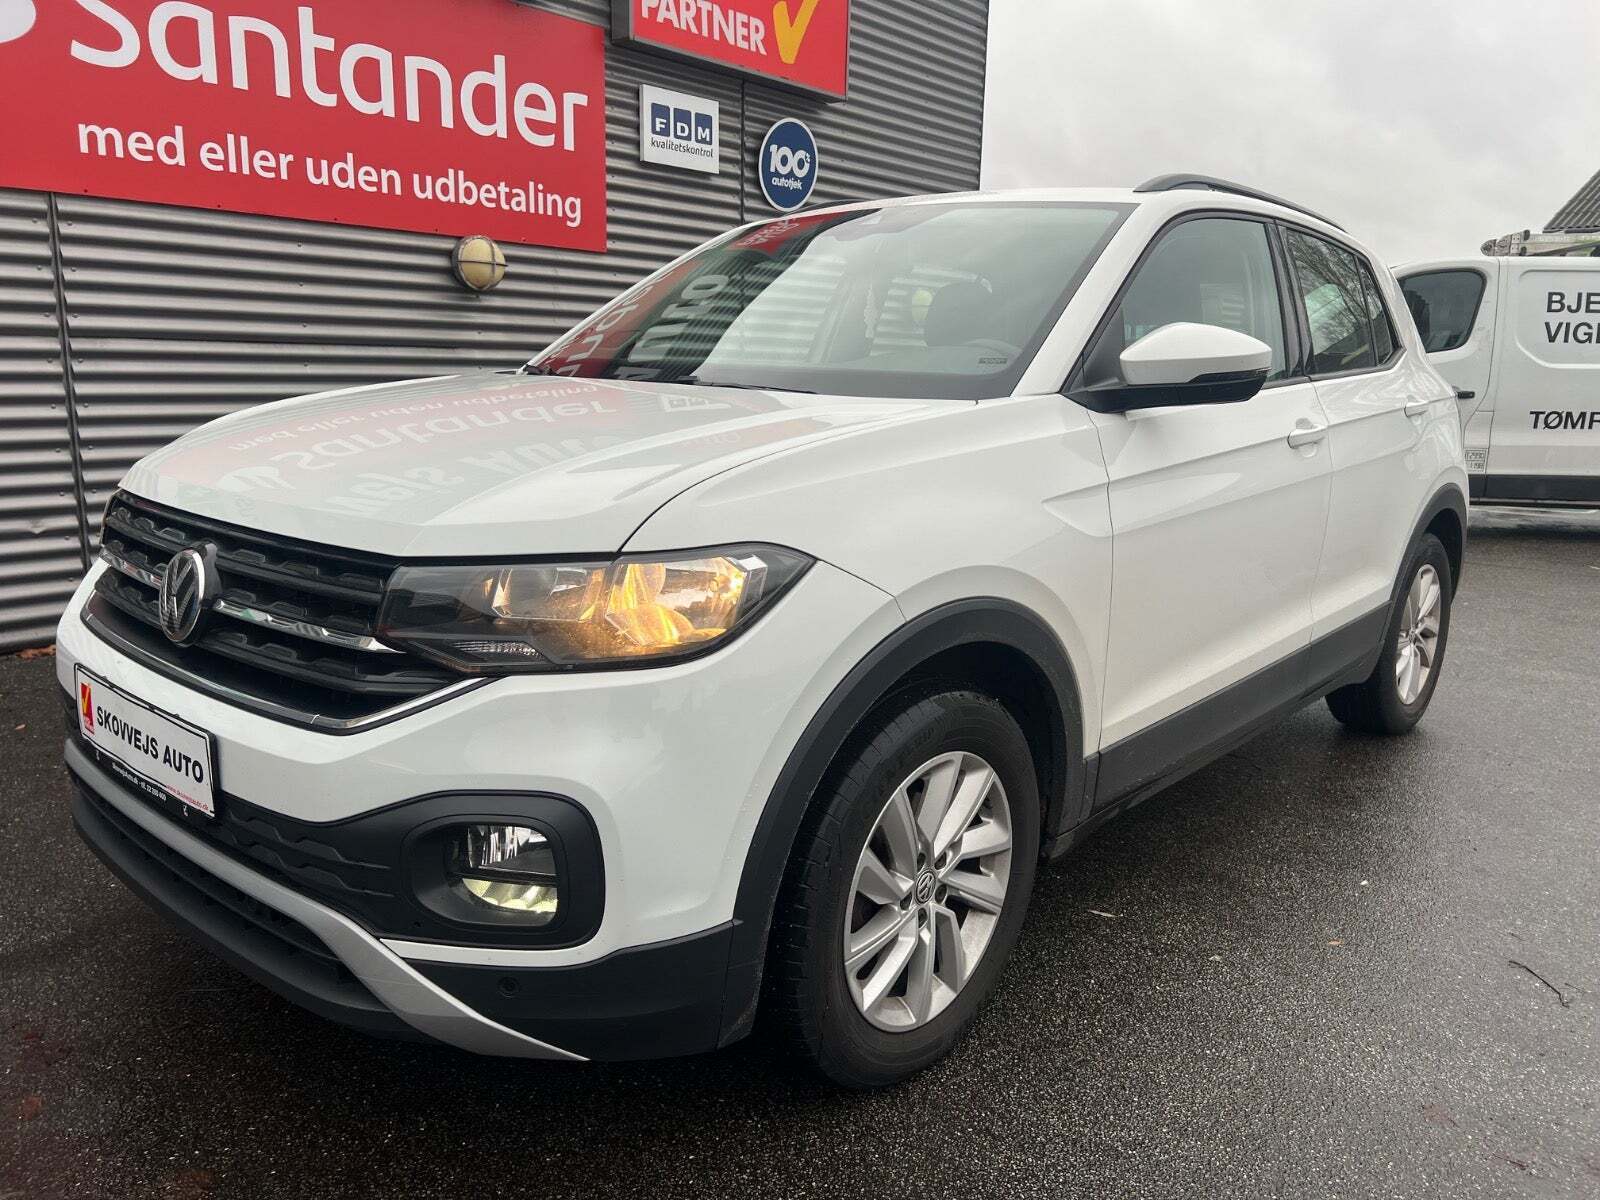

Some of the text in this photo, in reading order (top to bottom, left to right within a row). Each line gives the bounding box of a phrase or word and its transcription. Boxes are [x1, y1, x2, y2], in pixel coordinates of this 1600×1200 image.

[70, 0, 588, 152] Santander
[650, 137, 714, 158] kvalitetskontrol
[78, 123, 583, 228] med eller uden udbetaling
[771, 177, 803, 190] autotjek
[1544, 322, 1600, 344] VIG
[97, 705, 159, 760] SKOVVEJS
[163, 745, 204, 783] AUTO
